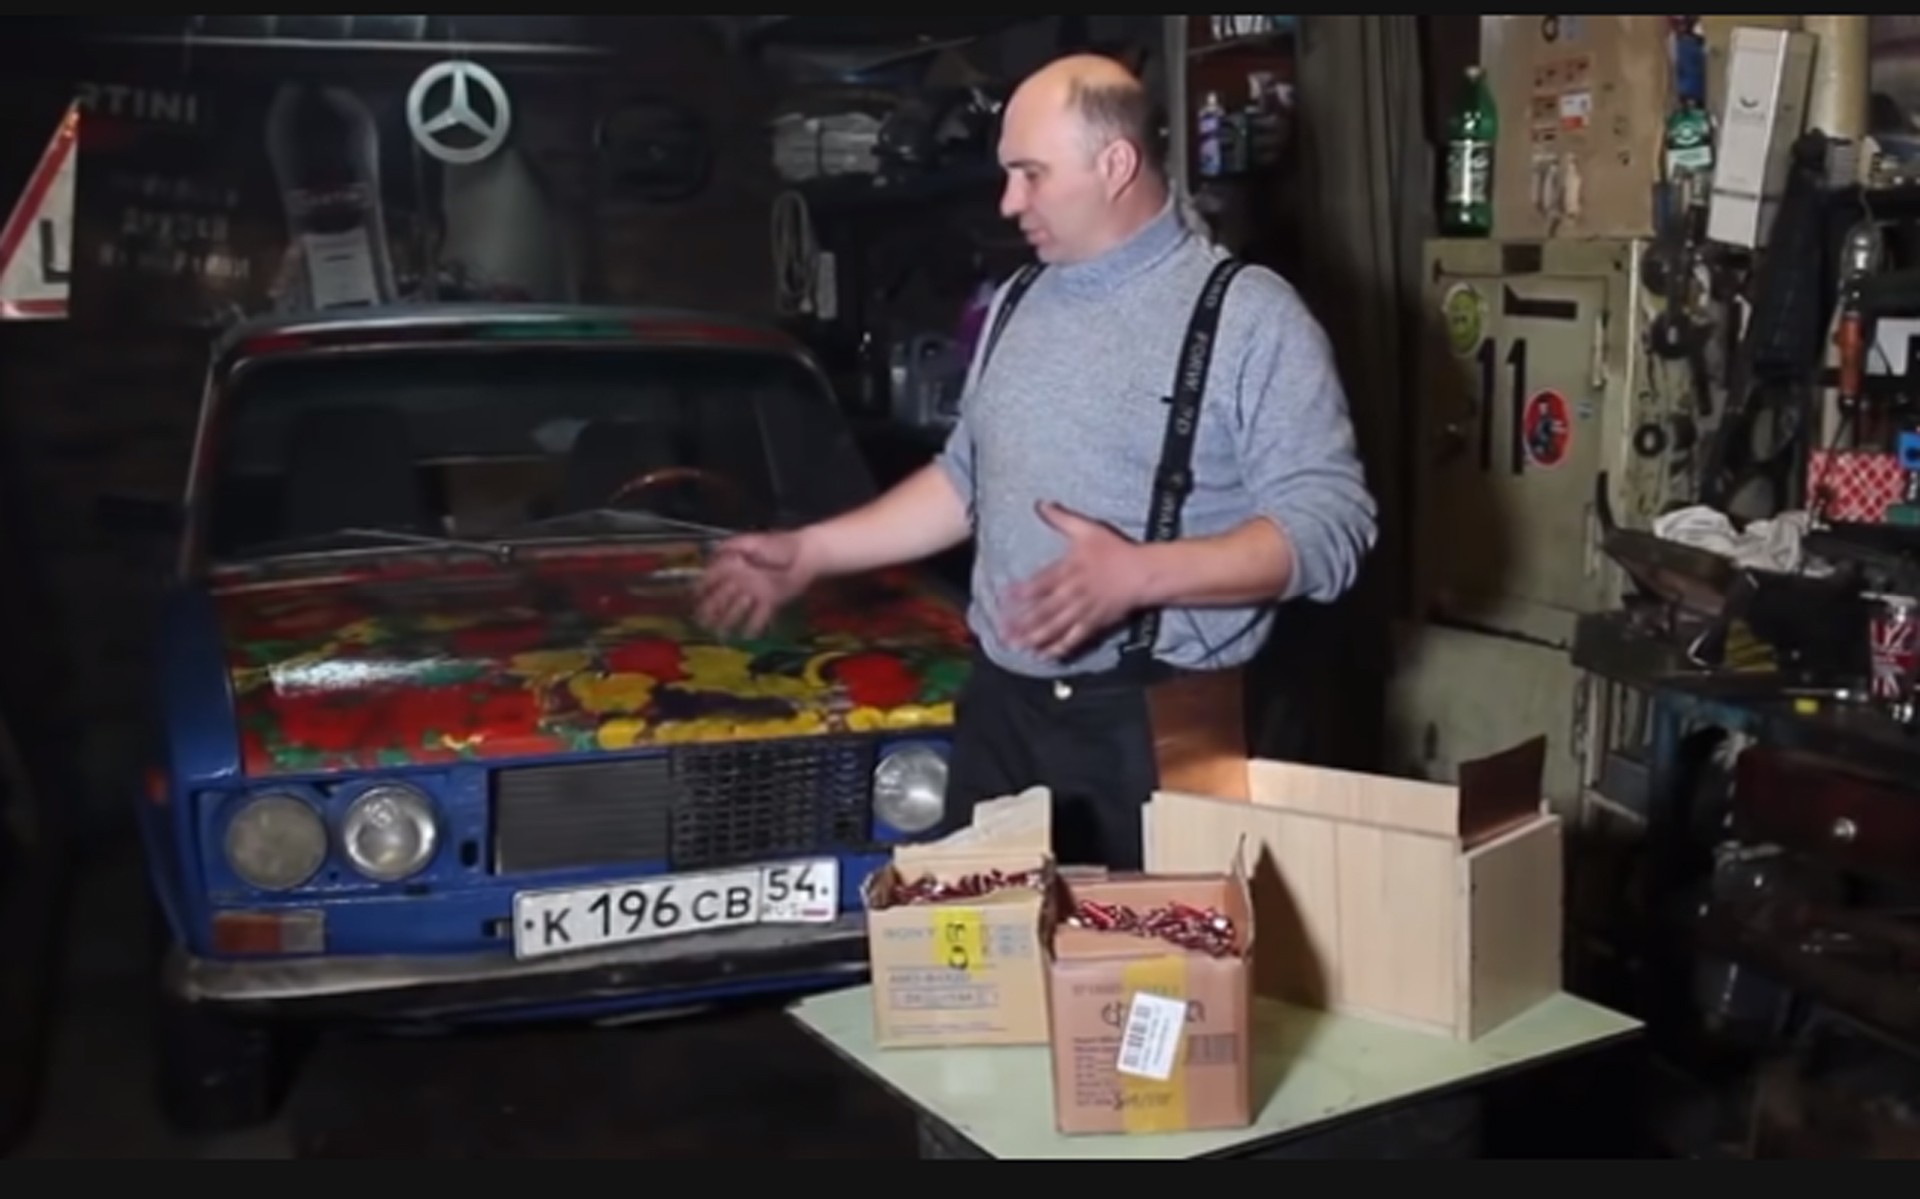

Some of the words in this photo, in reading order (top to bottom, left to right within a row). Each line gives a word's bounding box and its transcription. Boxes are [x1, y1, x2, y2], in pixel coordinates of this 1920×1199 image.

[1477, 337, 1527, 475] 11
[767, 865, 815, 901] 54
[588, 885, 681, 938] 196
